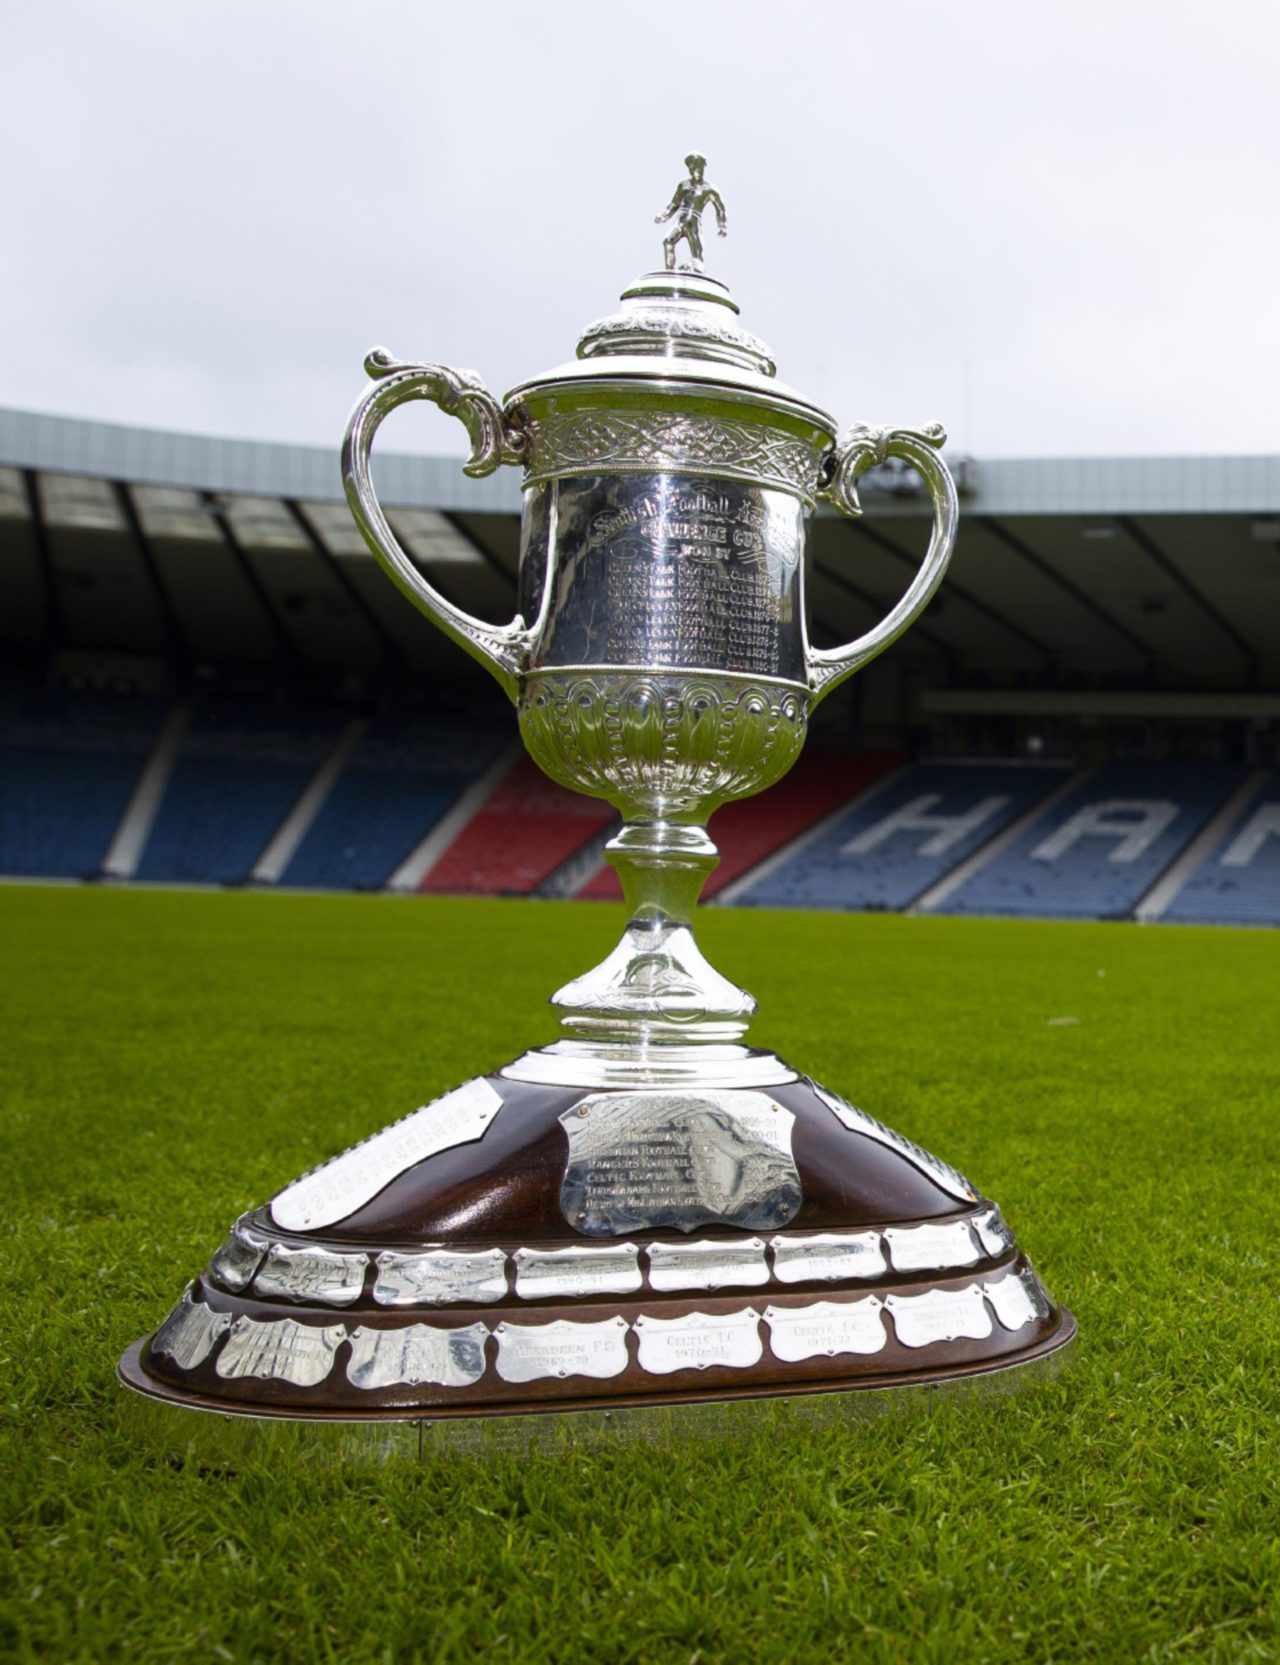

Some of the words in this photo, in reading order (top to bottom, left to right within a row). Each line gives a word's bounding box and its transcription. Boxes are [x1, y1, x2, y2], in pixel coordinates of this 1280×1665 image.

[716, 545, 732, 561] BY
[586, 1171, 627, 1183] CELTIC
[793, 1323, 833, 1337] CELTIC
[666, 1335, 711, 1348] CELTIC
[514, 1343, 586, 1357] ABERDEEN
